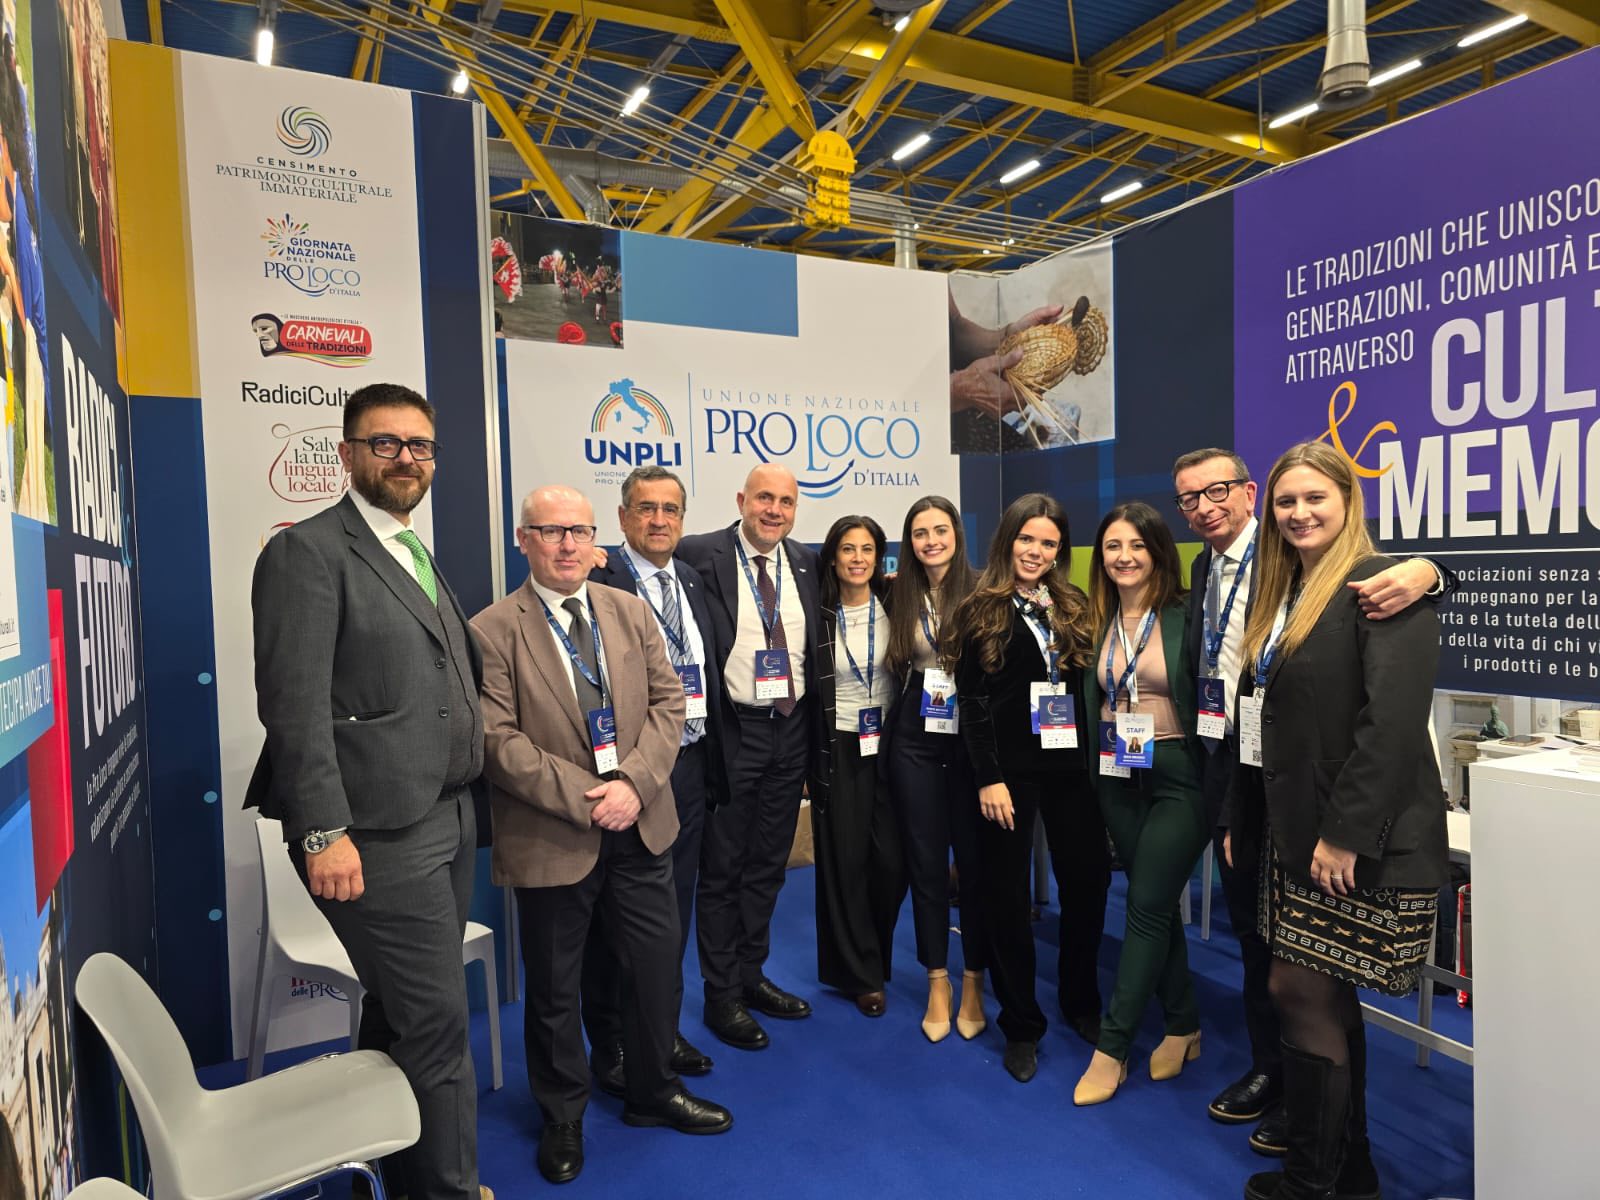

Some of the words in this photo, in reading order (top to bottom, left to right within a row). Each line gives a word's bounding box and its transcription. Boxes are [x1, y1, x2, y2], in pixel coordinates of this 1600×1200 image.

[257, 156, 357, 177] CENSIMENTO
[216, 165, 307, 186] PATRIMONIO
[312, 177, 392, 198] CULTURALE
[260, 182, 357, 203] IMMATERIALE
[286, 247, 356, 262] NAZIONALE
[290, 237, 352, 252] GIORNATA
[1286, 266, 1308, 299] LE
[1314, 228, 1432, 290] TRADIZIONI
[1442, 211, 1488, 256] CHE
[264, 262, 304, 282] PRO
[308, 266, 361, 287] LOCO
[330, 288, 360, 297] D'ITALIA
[1286, 278, 1430, 341] GENERAZIONI,
[1440, 234, 1577, 305] COMUNITÀ
[1588, 233, 1600, 271] E
[286, 324, 364, 344] CARNEVALI
[306, 342, 366, 354] TRADIZIONI
[1286, 329, 1414, 384] ATTRAVERSO
[1431, 289, 1600, 426] CUL
[703, 389, 791, 406] UNIONE
[805, 396, 920, 413] NAZIONALE
[704, 408, 797, 463] PRO
[805, 413, 920, 472] LOCO
[1314, 381, 1397, 478] &
[62, 333, 122, 548] RADICI
[294, 450, 308, 464] la
[314, 452, 340, 464] tua
[585, 438, 682, 466] UNPLI
[284, 461, 336, 481] lingua
[854, 470, 920, 486] D'ITALIA
[288, 478, 336, 492] locale
[1539, 569, 1590, 582] senza
[1546, 592, 1574, 607] per
[1582, 590, 1598, 606] la
[1470, 614, 1478, 626] e
[1485, 612, 1499, 626] la
[1506, 613, 1558, 628] tutela
[74, 553, 136, 750] FUTURO
[1448, 632, 1487, 648] della
[1494, 634, 1524, 650] vita
[1532, 636, 1547, 651] di
[1554, 638, 1580, 653] chi
[1464, 654, 1468, 668] i
[1474, 657, 1541, 674] prodotti
[1549, 663, 1558, 675] e
[1566, 661, 1581, 677] le
[1590, 662, 1598, 678] b
[24, 665, 43, 719] ANCHE
[292, 986, 308, 997] delle
